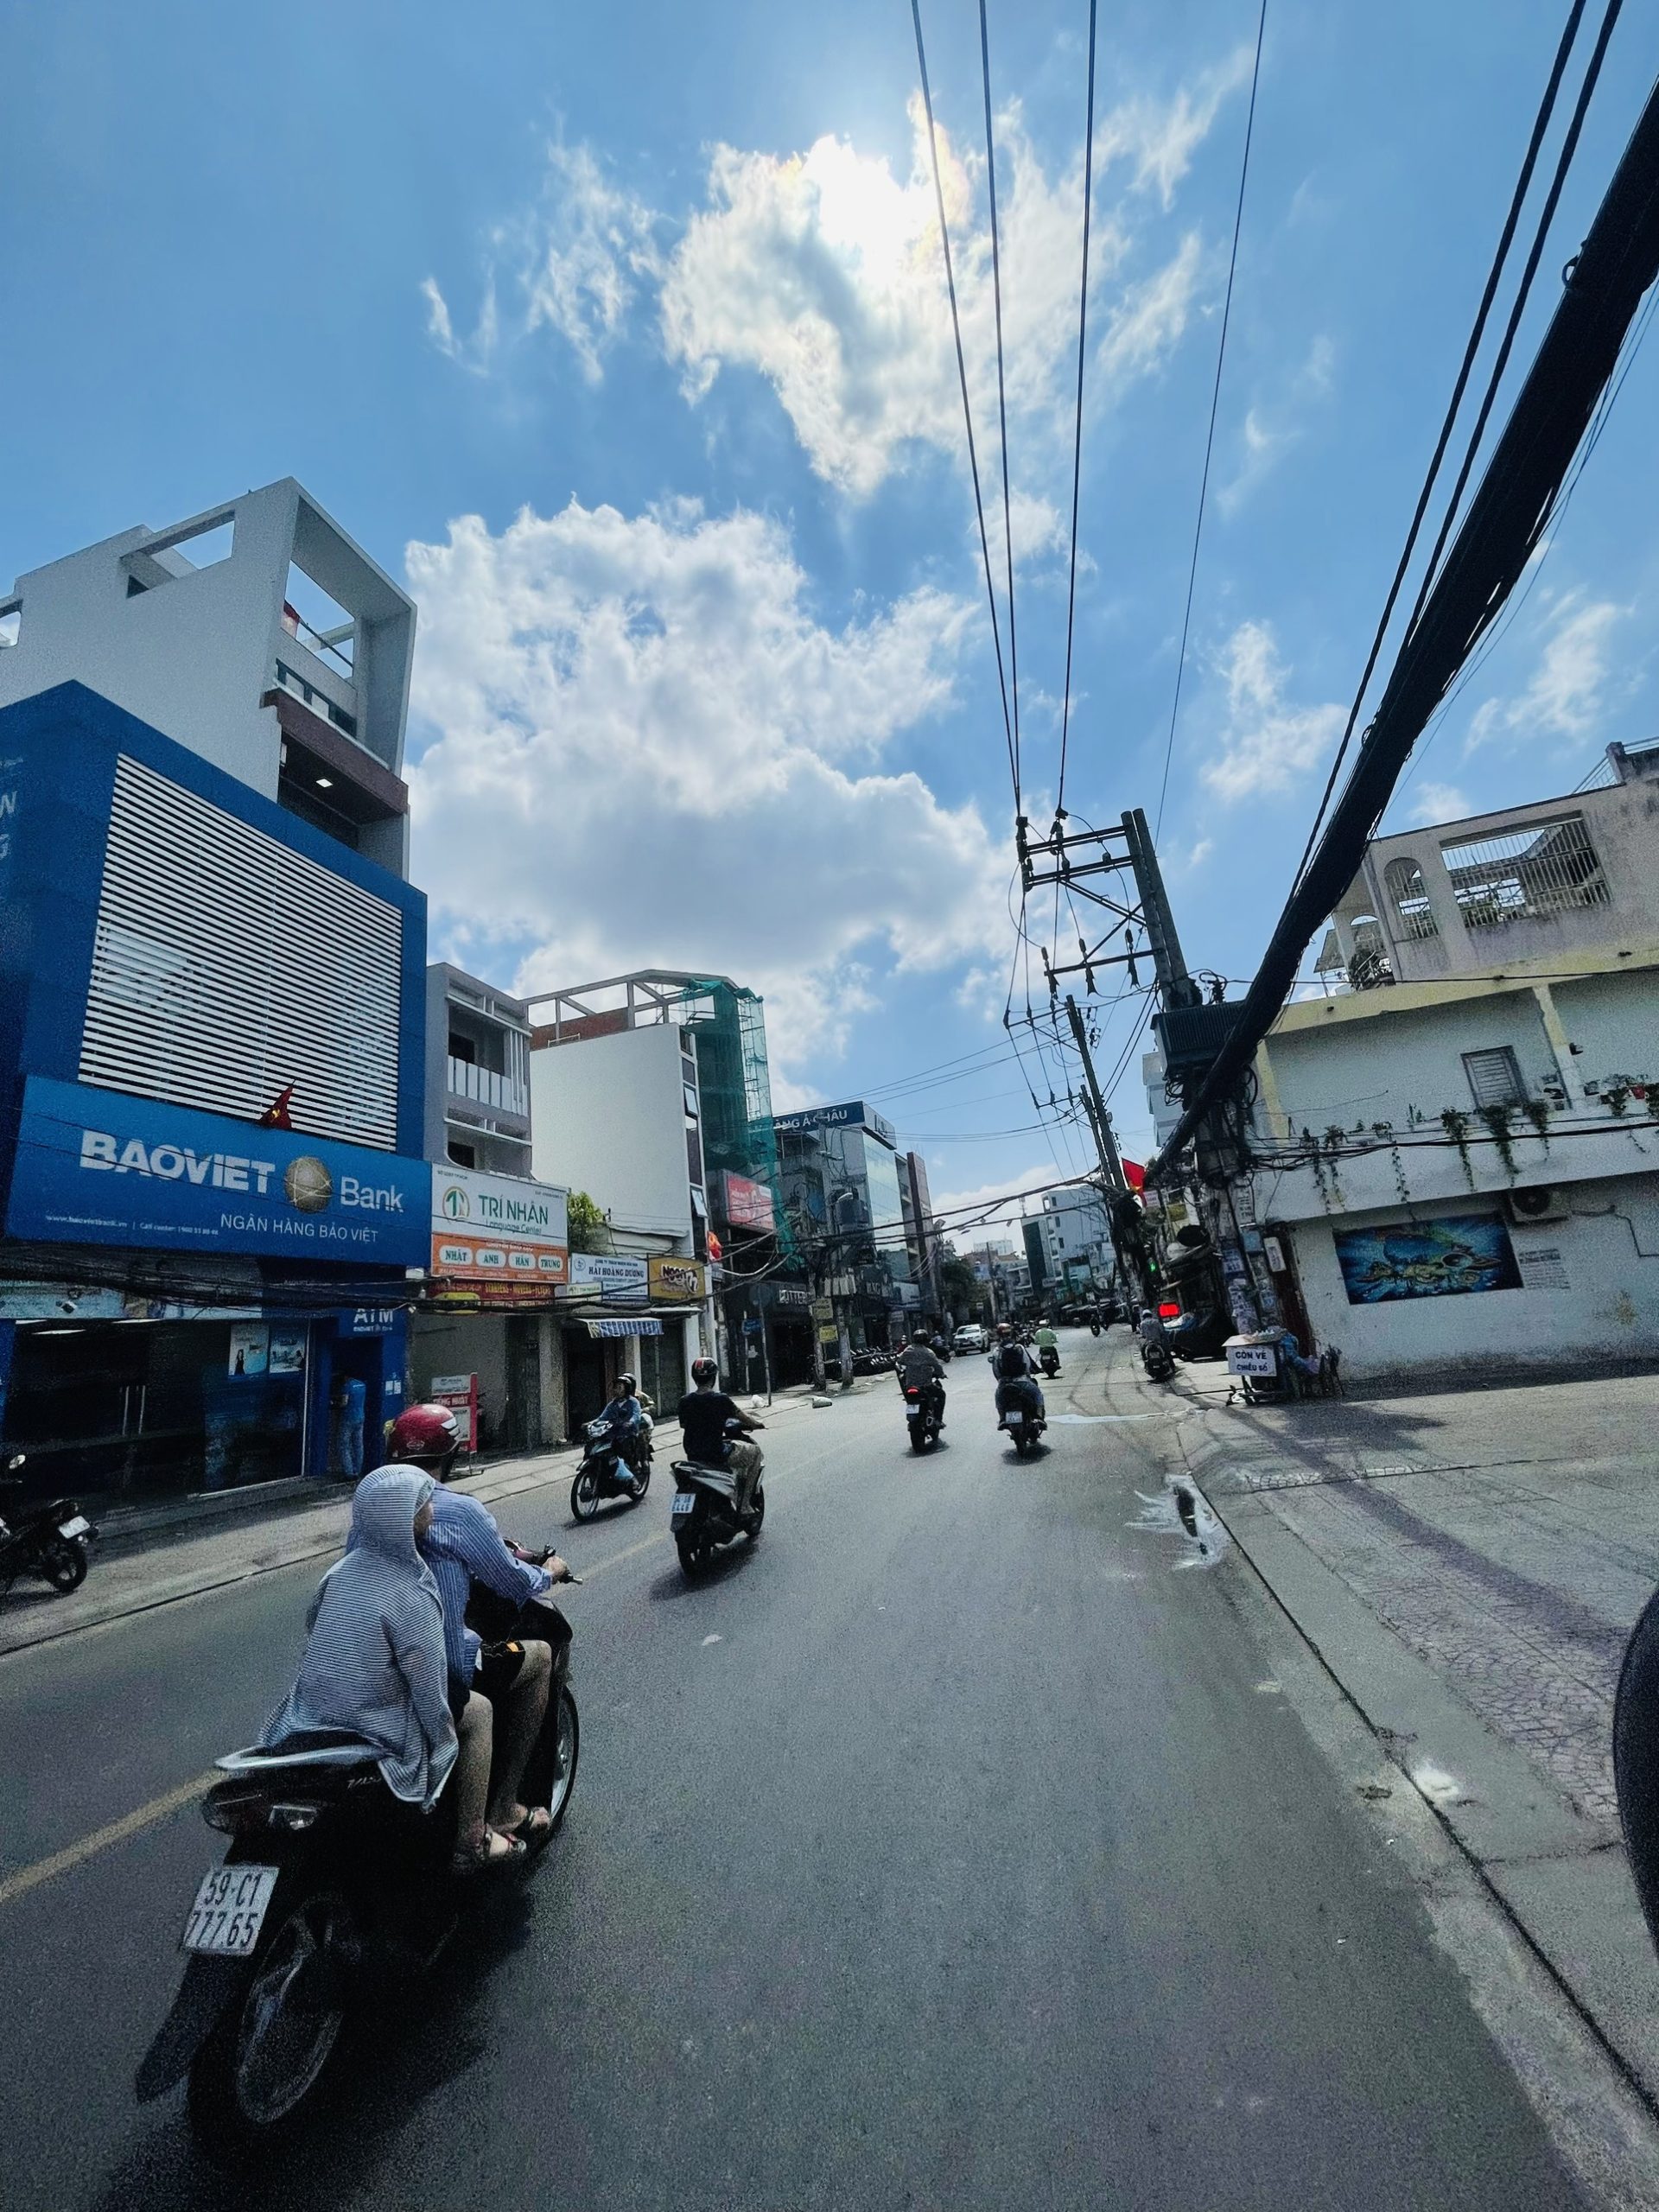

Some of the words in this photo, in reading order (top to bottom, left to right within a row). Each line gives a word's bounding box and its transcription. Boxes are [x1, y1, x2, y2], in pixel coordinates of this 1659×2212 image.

[79, 1129, 276, 1194] BAOVIET
[340, 1176, 404, 1212] Bank
[478, 1193, 504, 1218] TRÍ
[220, 1213, 268, 1232] NGÂN
[273, 1217, 315, 1236] HÀNG
[319, 1222, 347, 1240] BẢO
[351, 1226, 378, 1244] VIỆT
[484, 1254, 499, 1264] ANH
[540, 1258, 561, 1268] TRUNG
[602, 1265, 624, 1276] HOÀNG
[625, 1268, 645, 1278] DƯƠNG
[353, 1307, 394, 1323] ATM
[1236, 1348, 1254, 1360] CÒN
[205, 1872, 264, 1907] 59-C1
